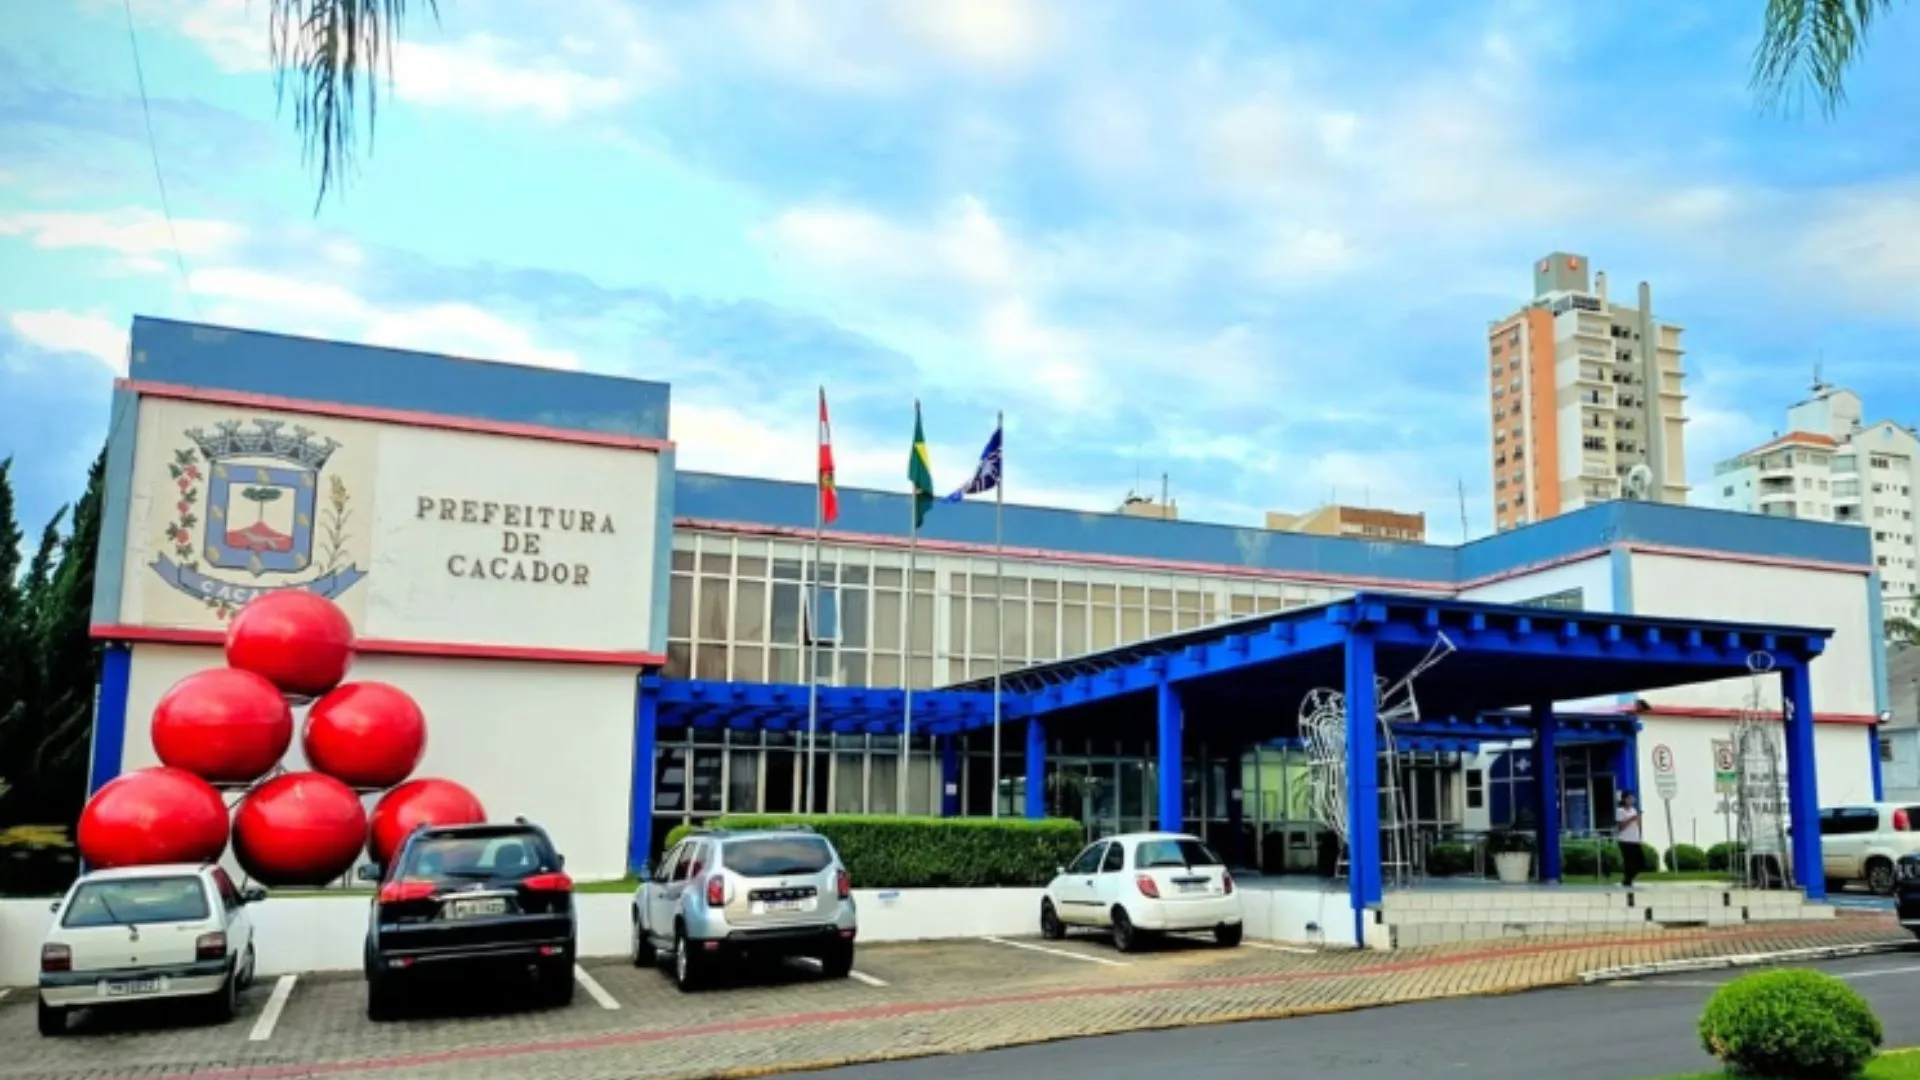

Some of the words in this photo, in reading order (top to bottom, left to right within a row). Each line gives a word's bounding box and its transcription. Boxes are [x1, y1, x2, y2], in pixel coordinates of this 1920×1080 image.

[416, 496, 615, 534] PREFEITURA
[502, 531, 541, 555] DE
[447, 554, 590, 586] CACADOR
